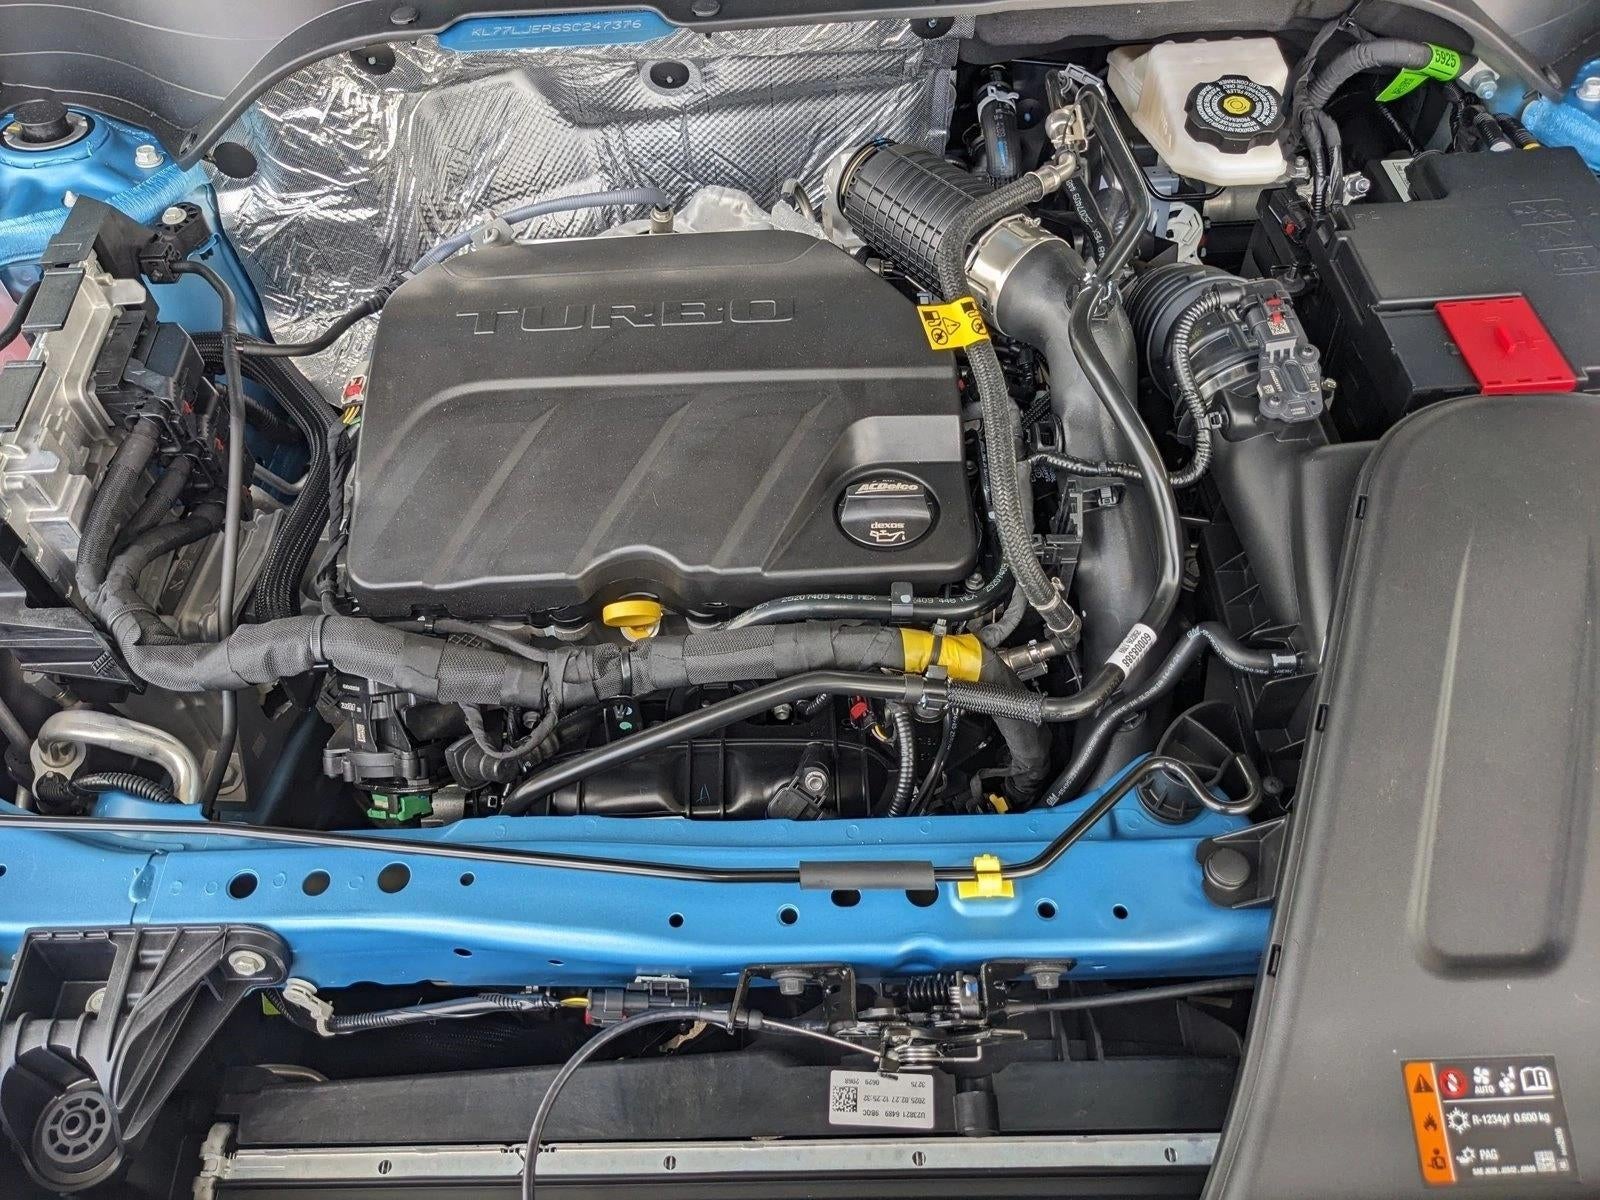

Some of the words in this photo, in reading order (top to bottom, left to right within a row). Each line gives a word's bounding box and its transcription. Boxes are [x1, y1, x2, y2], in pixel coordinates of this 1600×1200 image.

[1435, 49, 1457, 68] 5925
[456, 298, 796, 335] TURBO
[855, 482, 919, 494] ACDelco
[1474, 1085, 1495, 1095] AUTO
